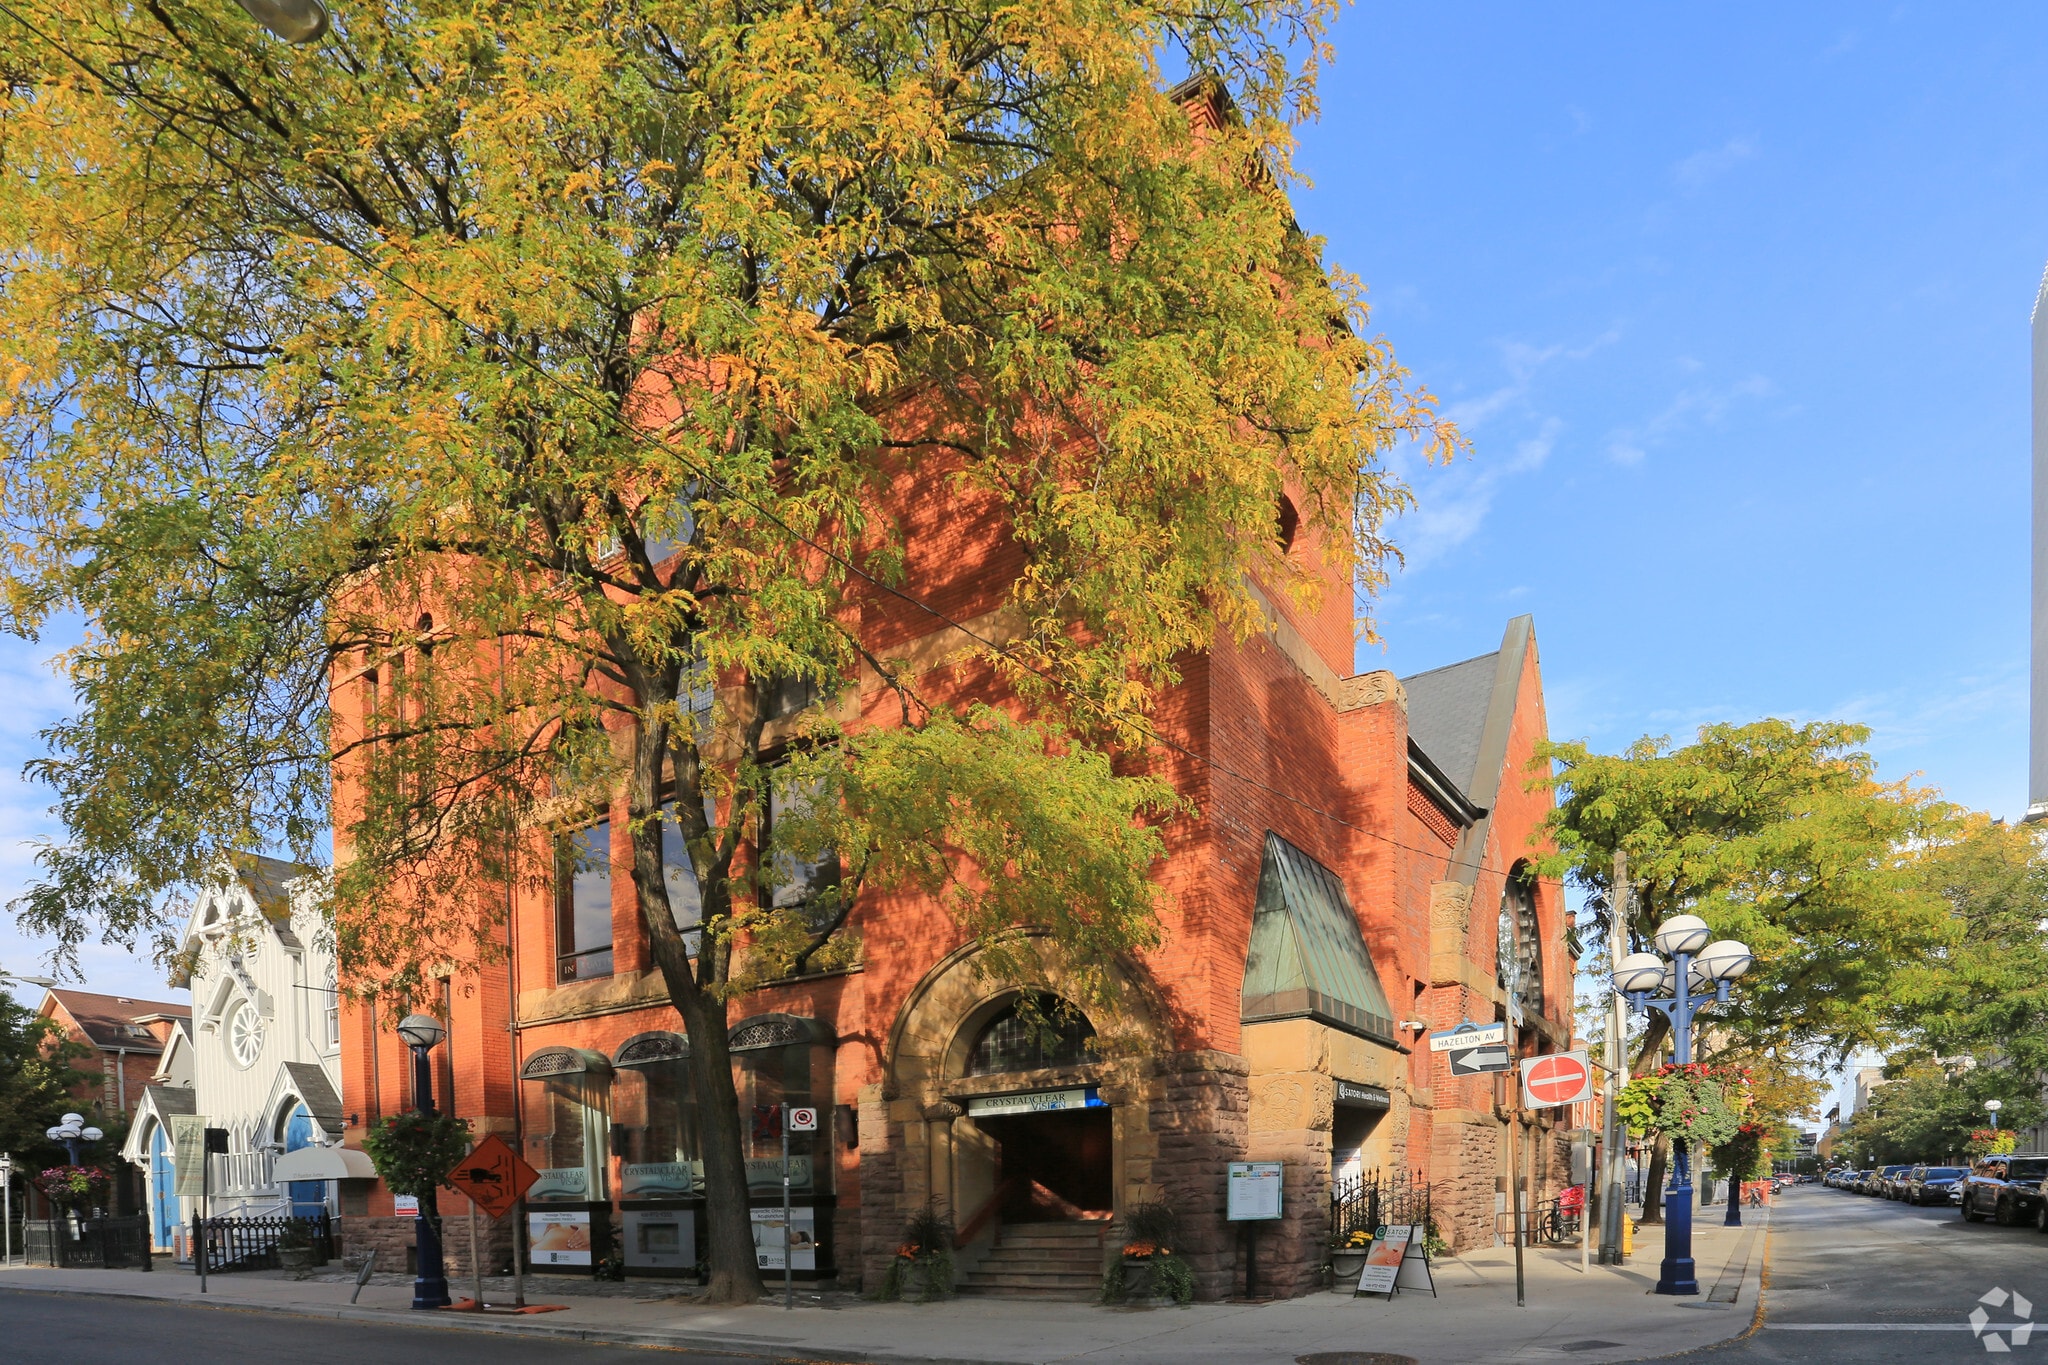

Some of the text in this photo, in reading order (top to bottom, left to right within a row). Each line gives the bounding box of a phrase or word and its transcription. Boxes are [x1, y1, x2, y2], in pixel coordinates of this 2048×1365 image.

[1438, 1032, 1495, 1048] HAZELTON AV
[1345, 1088, 1360, 1099] SATORI
[985, 1093, 1065, 1107] CRYSTAL CLEAR
[560, 1170, 584, 1179] CLEAR
[624, 1165, 688, 1176] CRYSTAL CLEAR
